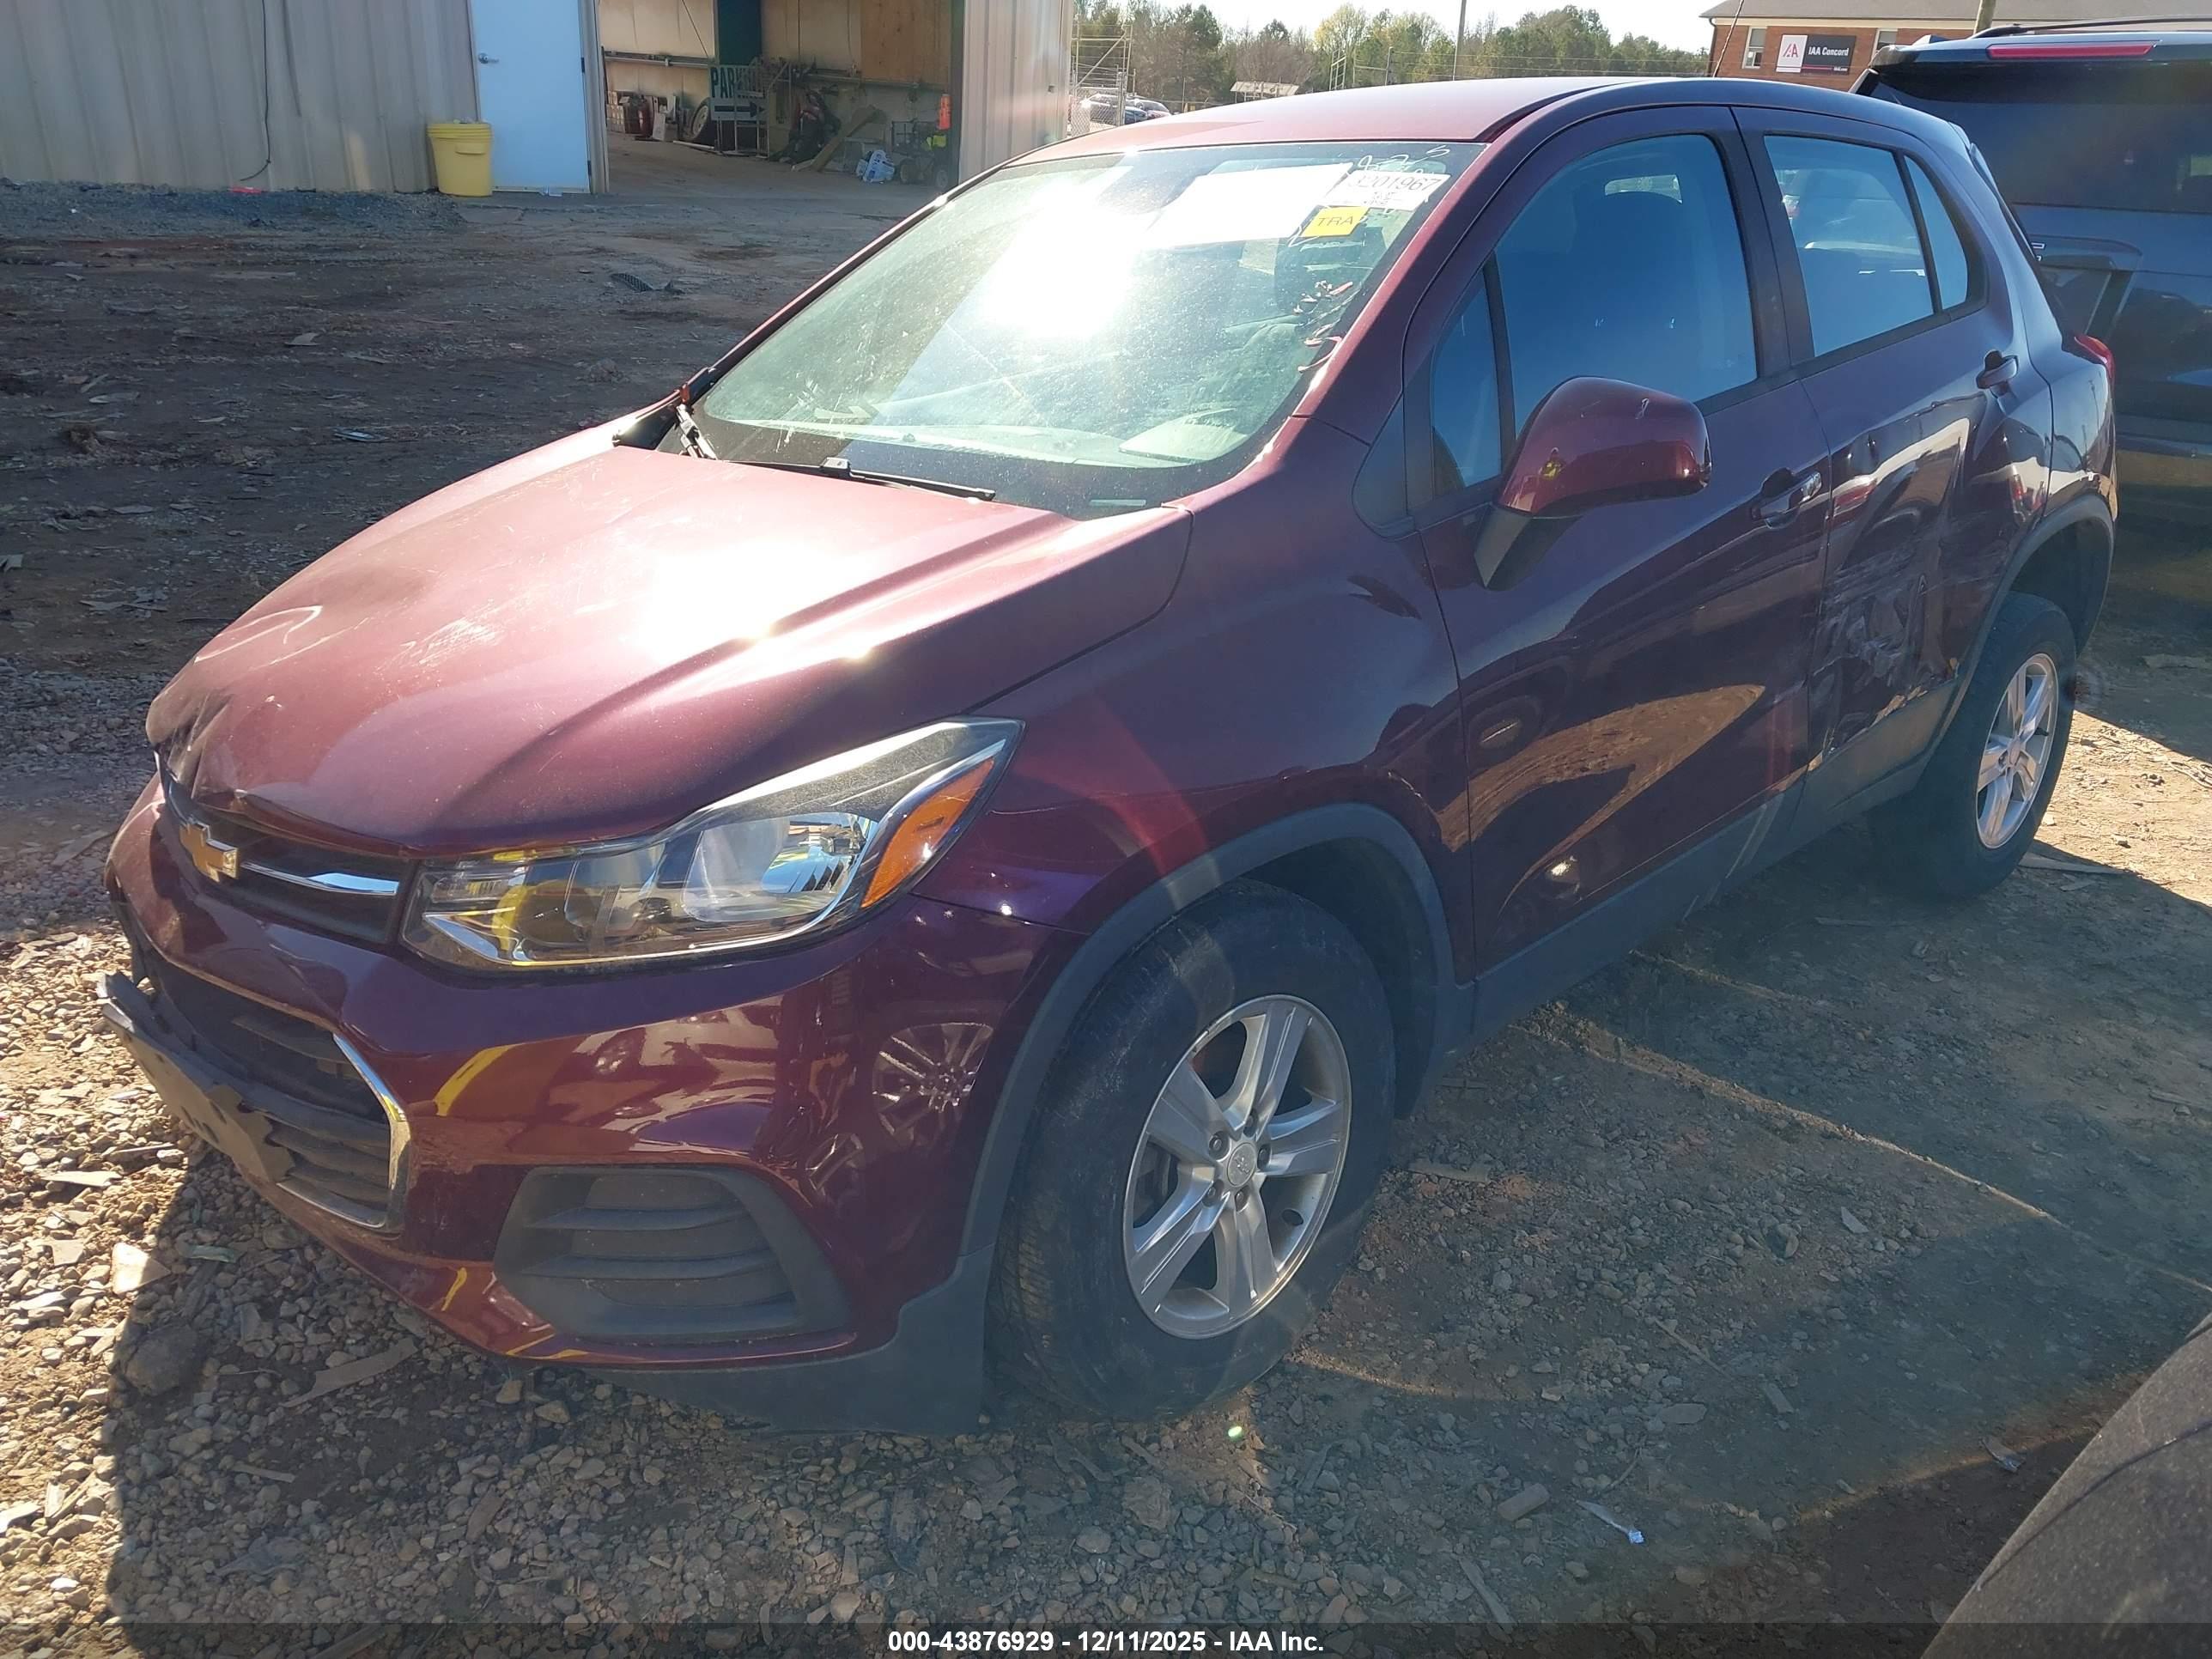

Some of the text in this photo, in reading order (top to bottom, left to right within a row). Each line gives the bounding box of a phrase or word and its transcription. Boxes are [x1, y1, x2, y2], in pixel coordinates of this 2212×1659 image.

[1808, 46, 1850, 57] IAA Concord
[1316, 215, 1353, 227] TRA
